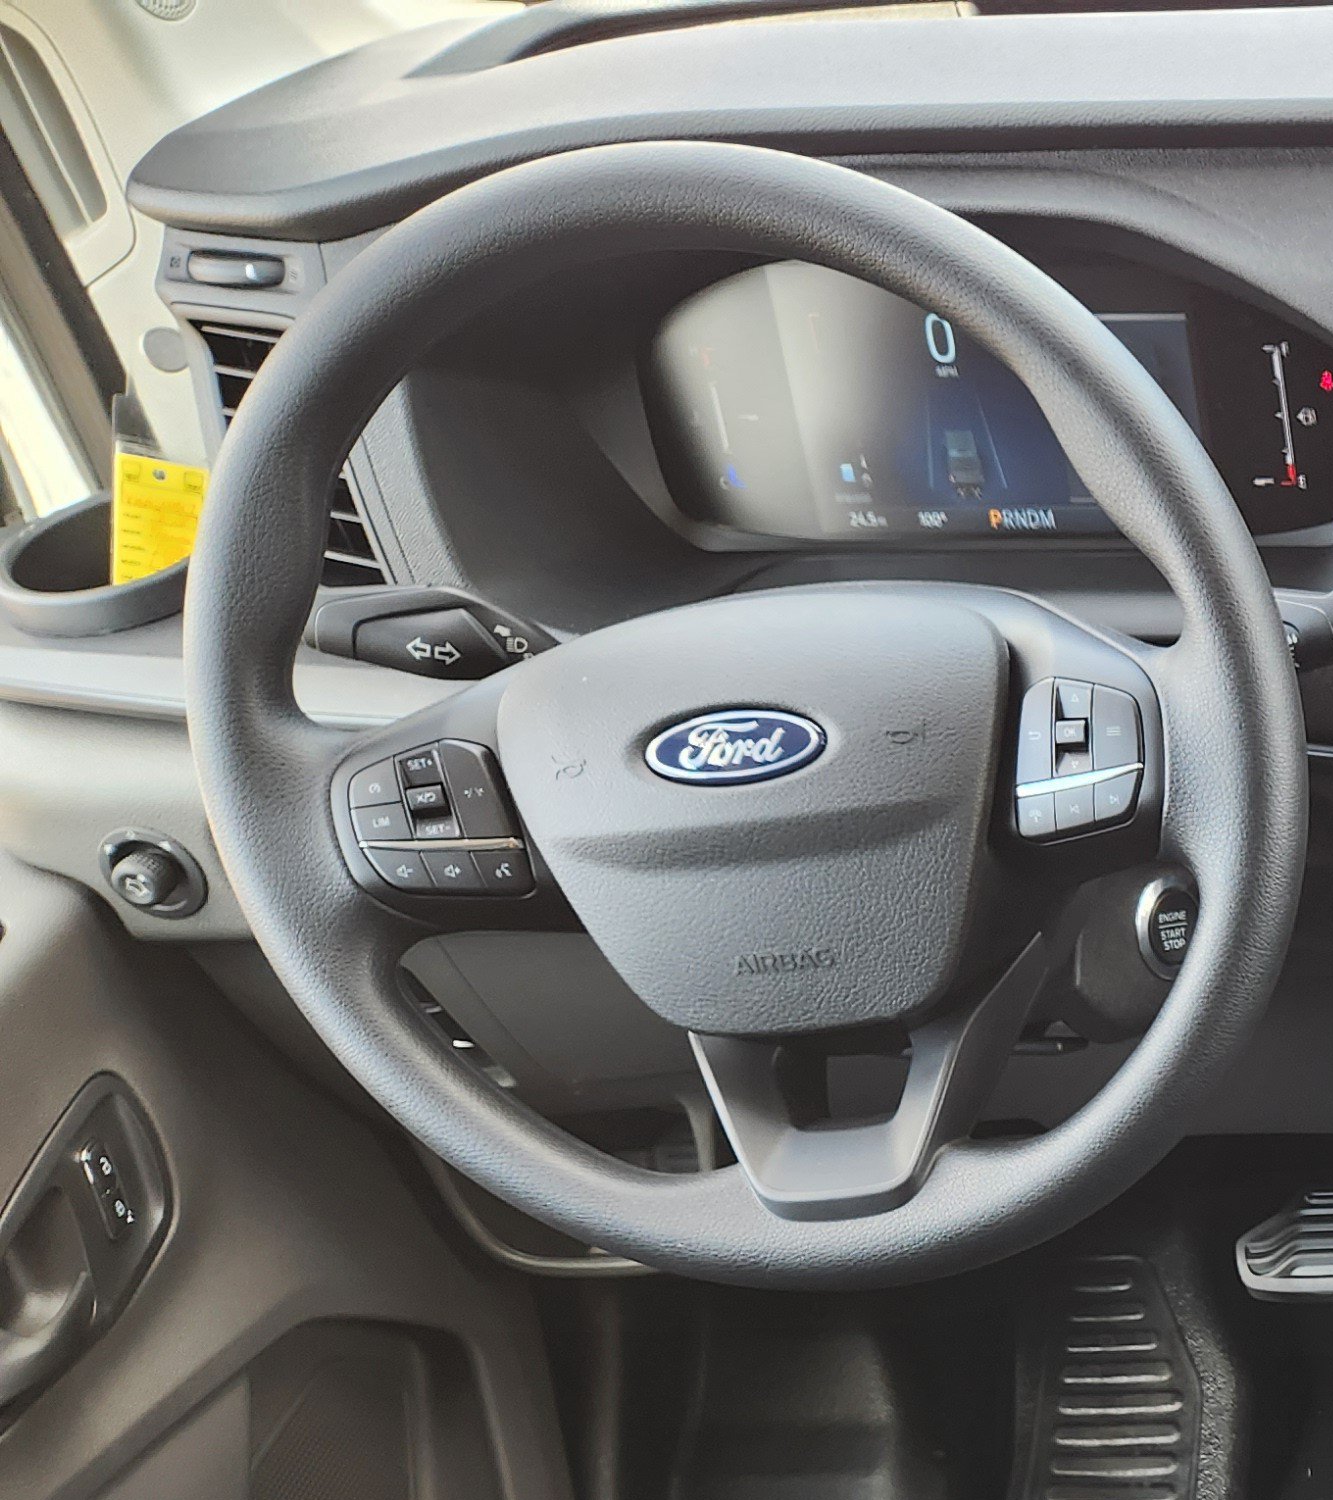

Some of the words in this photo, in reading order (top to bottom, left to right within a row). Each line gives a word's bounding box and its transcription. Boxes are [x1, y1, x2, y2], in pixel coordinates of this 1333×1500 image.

[925, 312, 956, 364] 0
[678, 720, 786, 770] Ford
[1158, 911, 1187, 924] ENGINE
[1161, 927, 1186, 940] START
[1163, 937, 1187, 951] STOP
[736, 948, 836, 976] AIRBAG
